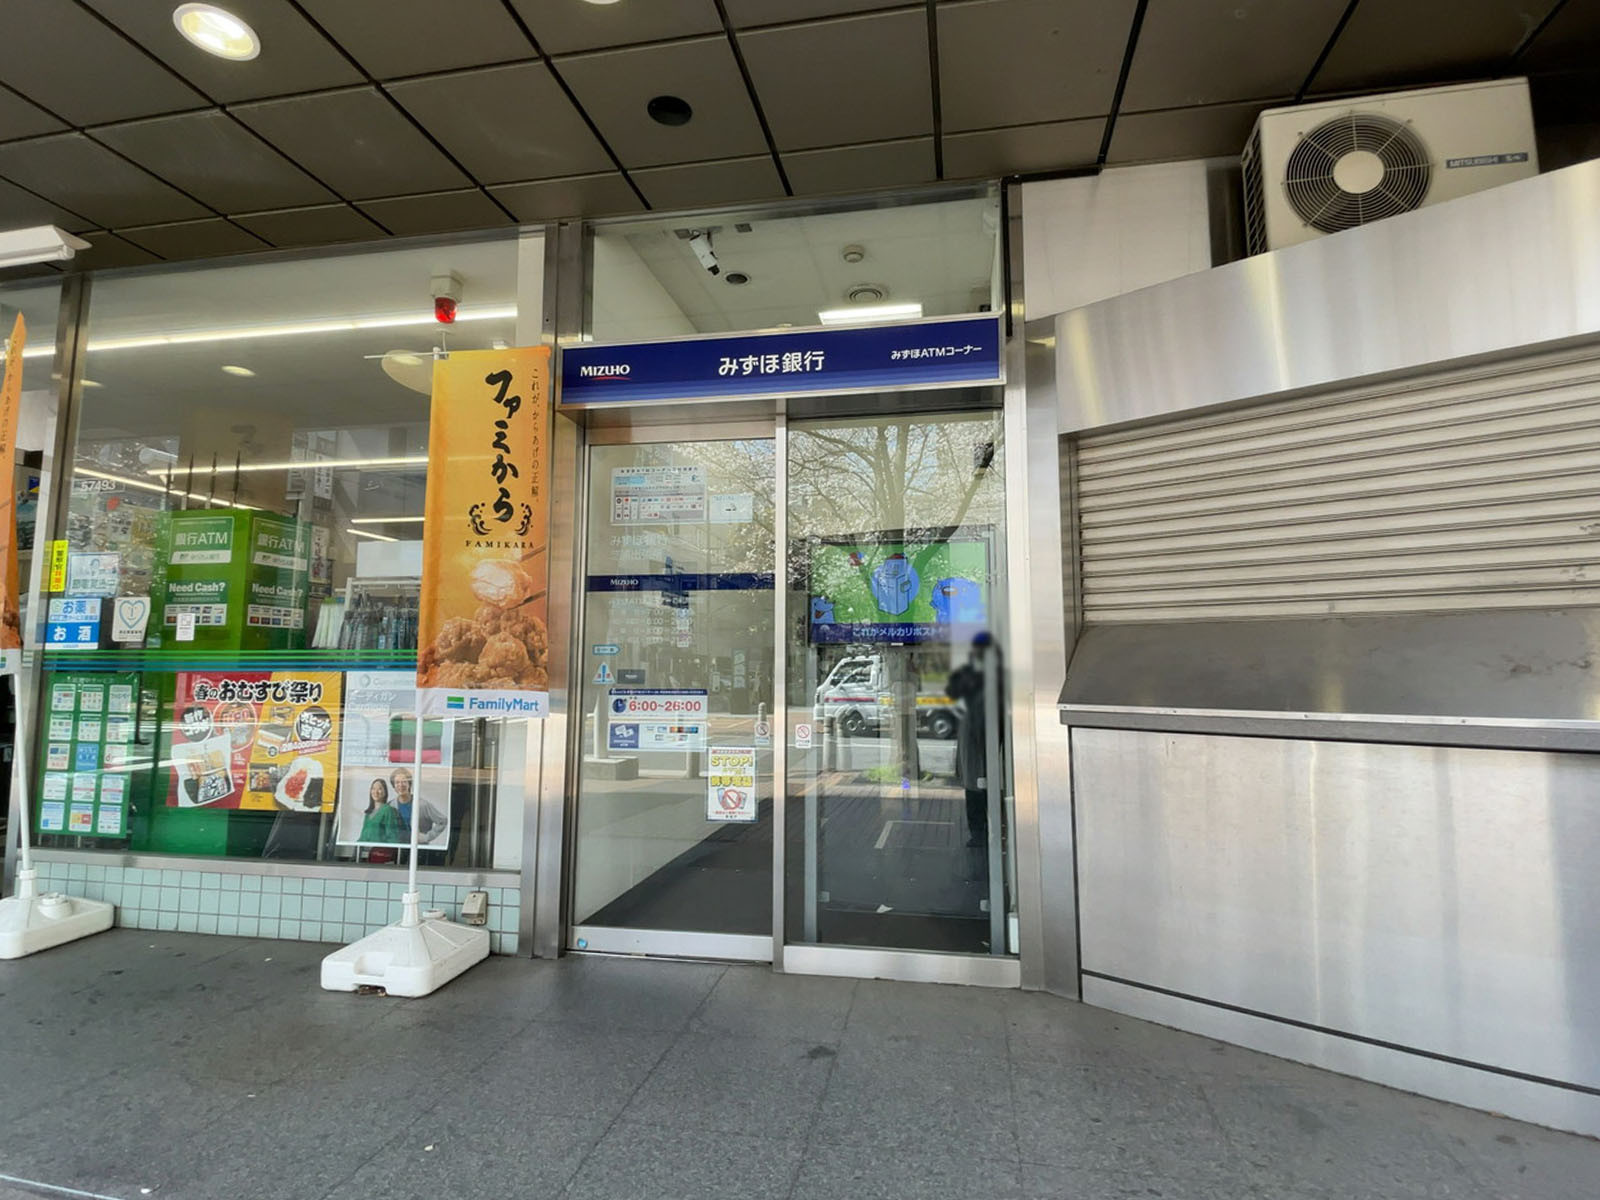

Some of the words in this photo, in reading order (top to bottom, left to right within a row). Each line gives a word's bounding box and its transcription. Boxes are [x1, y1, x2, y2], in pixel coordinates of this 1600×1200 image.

[890, 344, 983, 361] みずほATMコーナー
[580, 363, 631, 377] MIZUHO
[717, 350, 826, 377] みずほ銀行
[484, 369, 522, 523] ファミから
[465, 539, 535, 550] FAMIKARA
[169, 583, 193, 593] Need
[195, 582, 226, 593] Cash?
[252, 583, 275, 595] Need
[610, 578, 639, 587] MIZUHO
[194, 680, 323, 704] 春のおむすび祭り
[469, 697, 539, 712] FamilyMart
[711, 755, 754, 767] STOP!
